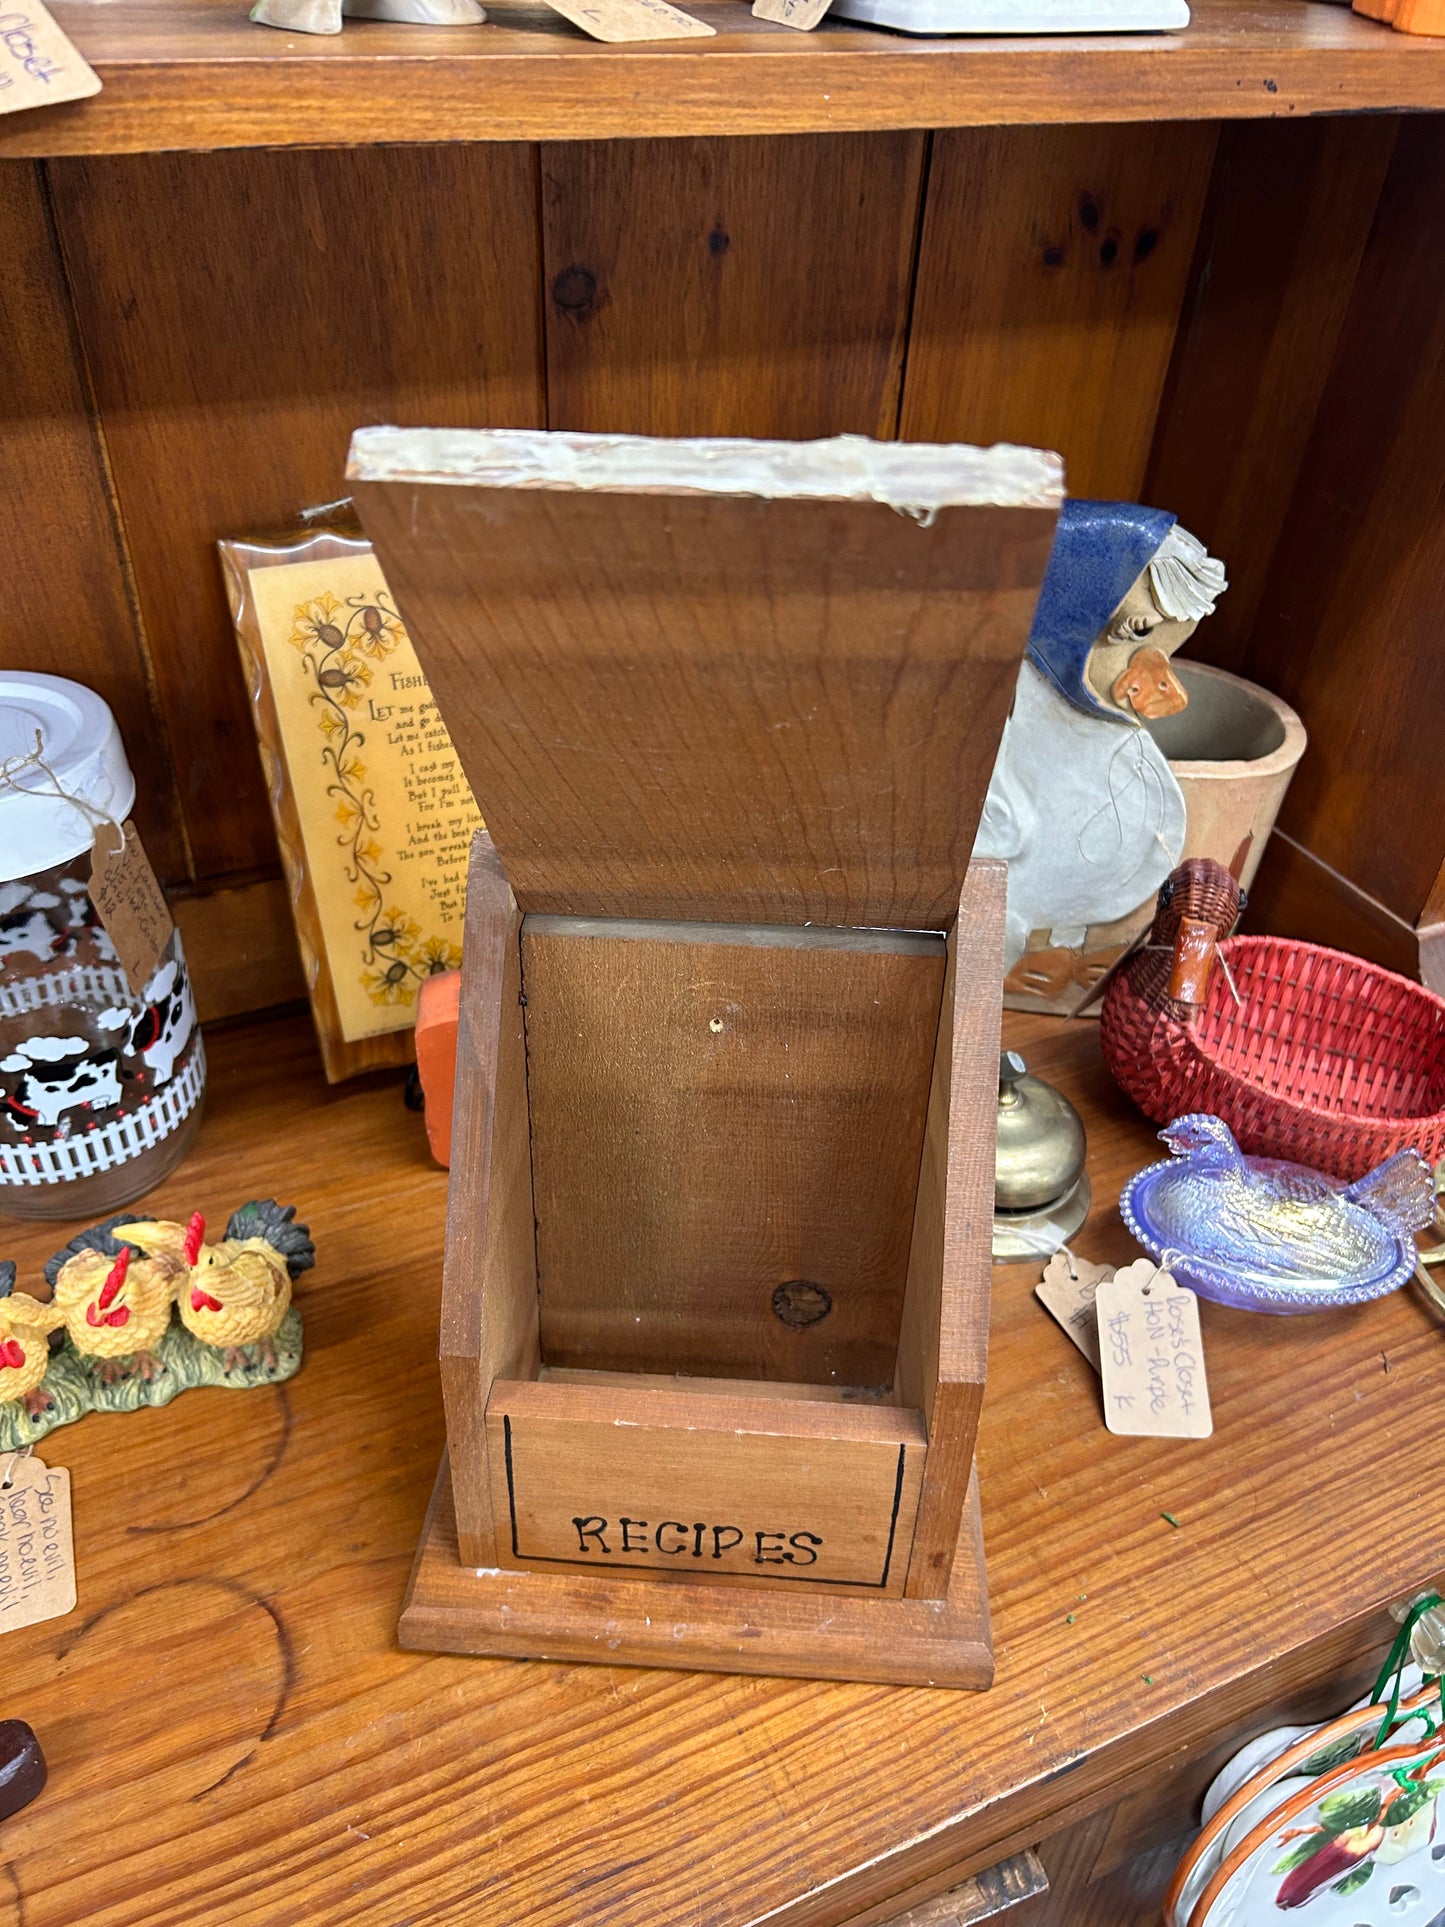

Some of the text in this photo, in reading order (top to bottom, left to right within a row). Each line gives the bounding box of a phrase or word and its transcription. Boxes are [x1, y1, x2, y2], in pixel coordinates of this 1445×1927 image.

[368, 698, 394, 721] LET
[400, 705, 414, 714] me
[396, 717, 414, 730] and
[407, 733, 420, 742] me
[401, 744, 415, 757] As
[442, 760, 455, 773] my
[416, 774, 455, 786] becomes
[408, 789, 427, 802] But
[441, 783, 460, 799] pull
[418, 801, 434, 812] For
[416, 819, 442, 832] break
[448, 818, 462, 829] my
[408, 833, 429, 846] And
[433, 831, 448, 842] the
[396, 849, 415, 861] The
[443, 871, 460, 884] had
[572, 1516, 823, 1566] RECIPES
